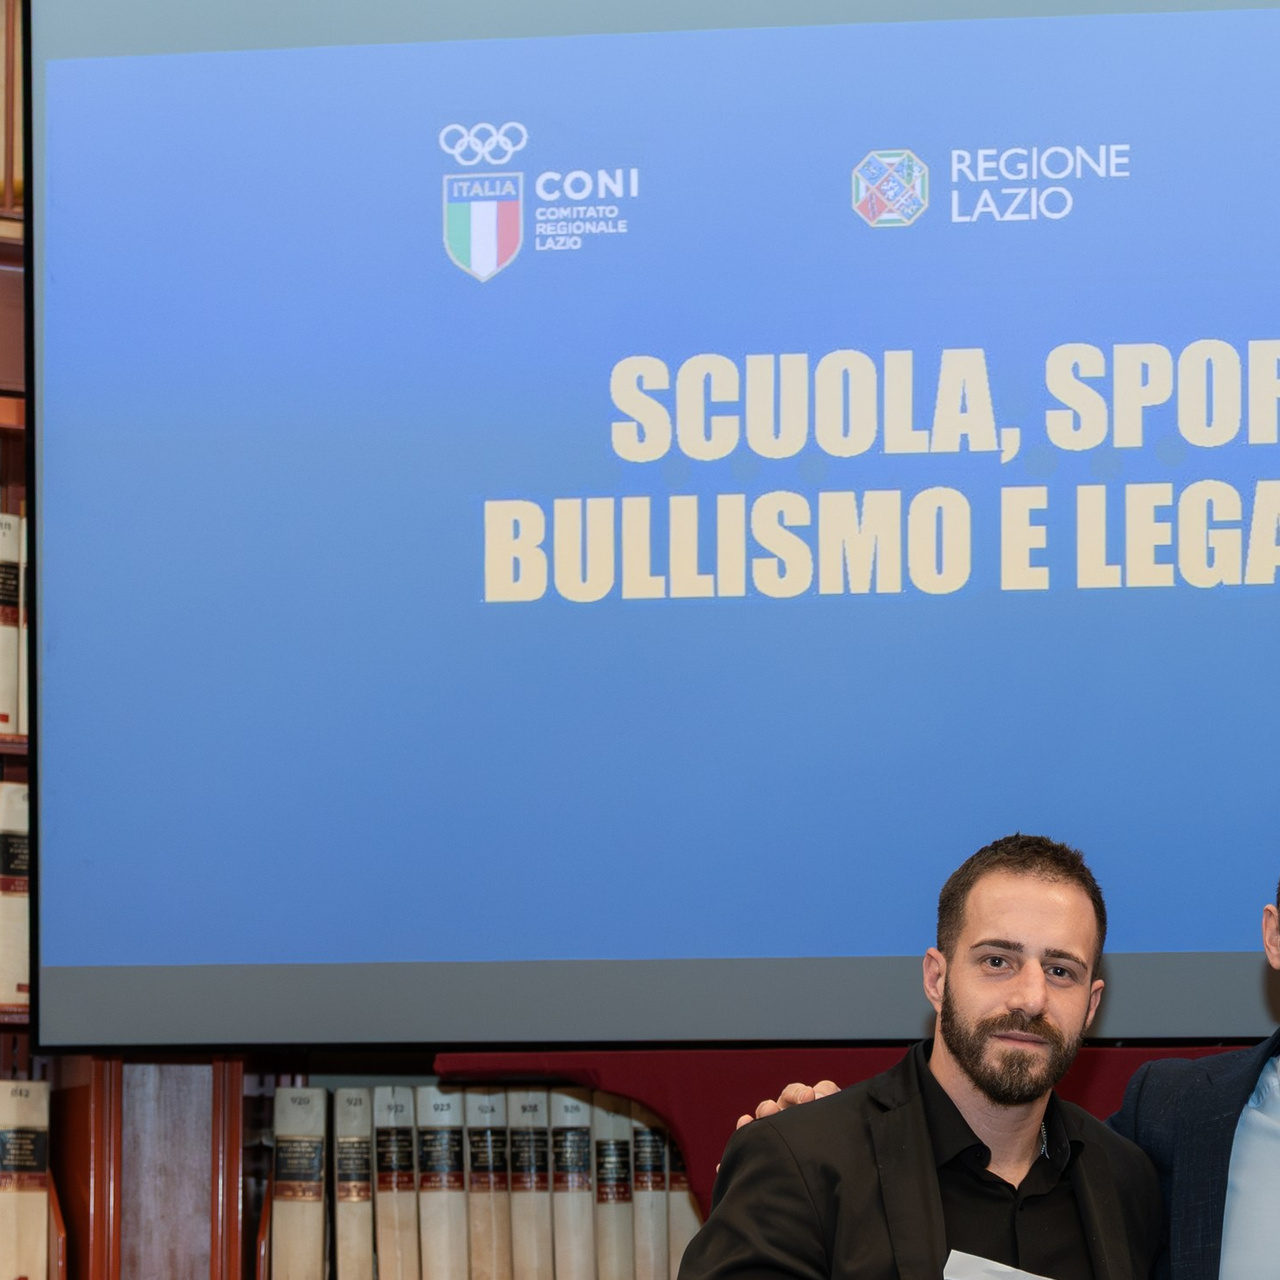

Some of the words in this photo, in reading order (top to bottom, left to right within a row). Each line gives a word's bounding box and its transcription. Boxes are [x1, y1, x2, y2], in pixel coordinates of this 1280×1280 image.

[952, 145, 1129, 182] REGIONE
[452, 181, 517, 198] ITALIA
[536, 169, 638, 200] CONI
[535, 205, 618, 221] COMITATO
[952, 187, 1072, 222] LAZIO
[535, 220, 628, 235] REGIONALE
[535, 236, 582, 251] LAZIO
[611, 348, 1020, 463] SCUOLA,
[485, 487, 970, 602] BULLISMO
[1001, 486, 1048, 590] E
